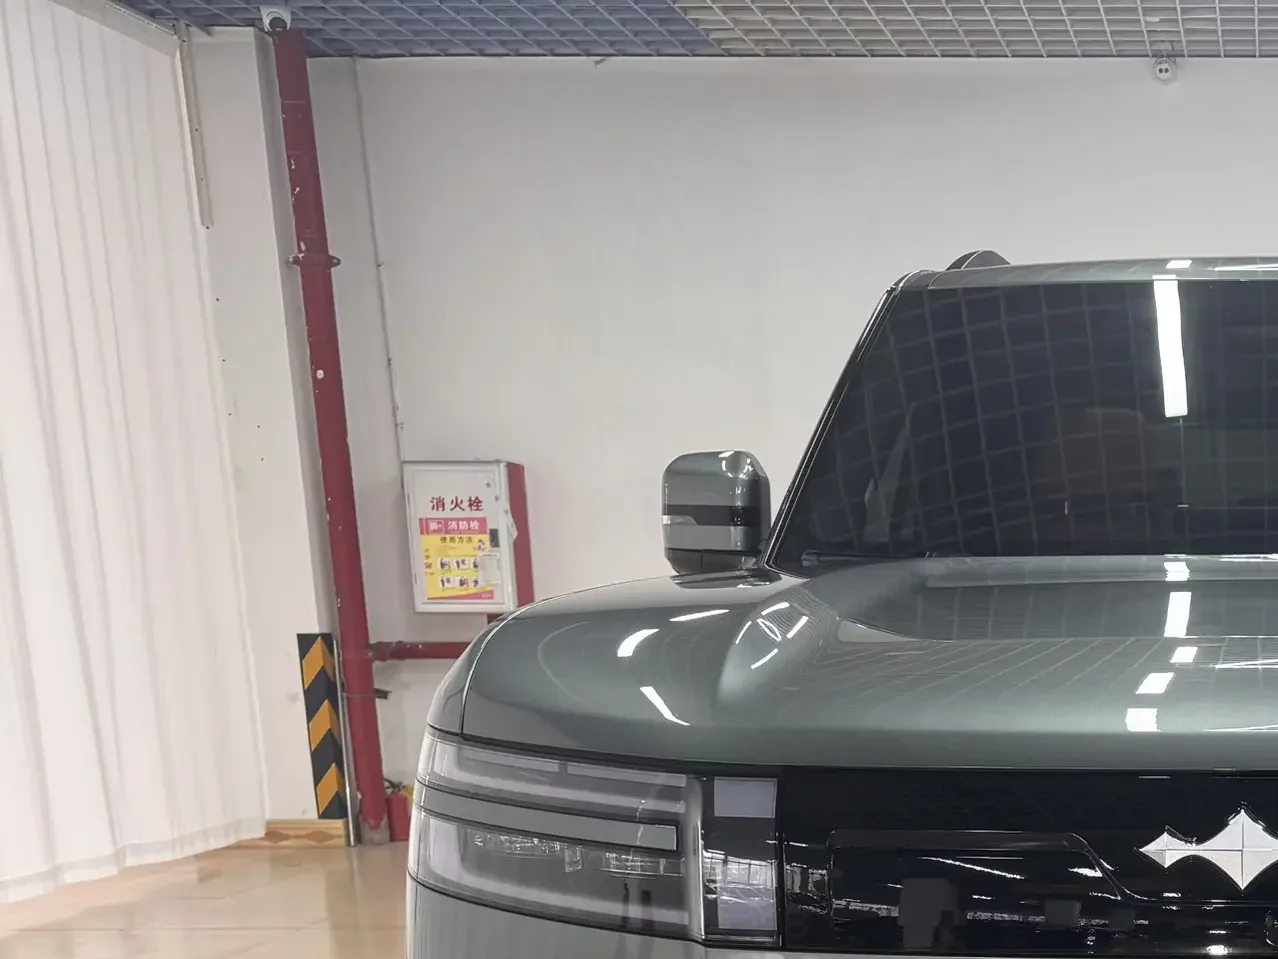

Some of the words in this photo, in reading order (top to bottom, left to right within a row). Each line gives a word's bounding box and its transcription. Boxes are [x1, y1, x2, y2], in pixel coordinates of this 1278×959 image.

[430, 495, 484, 512] 消火栓
[447, 520, 480, 531] 消防栓
